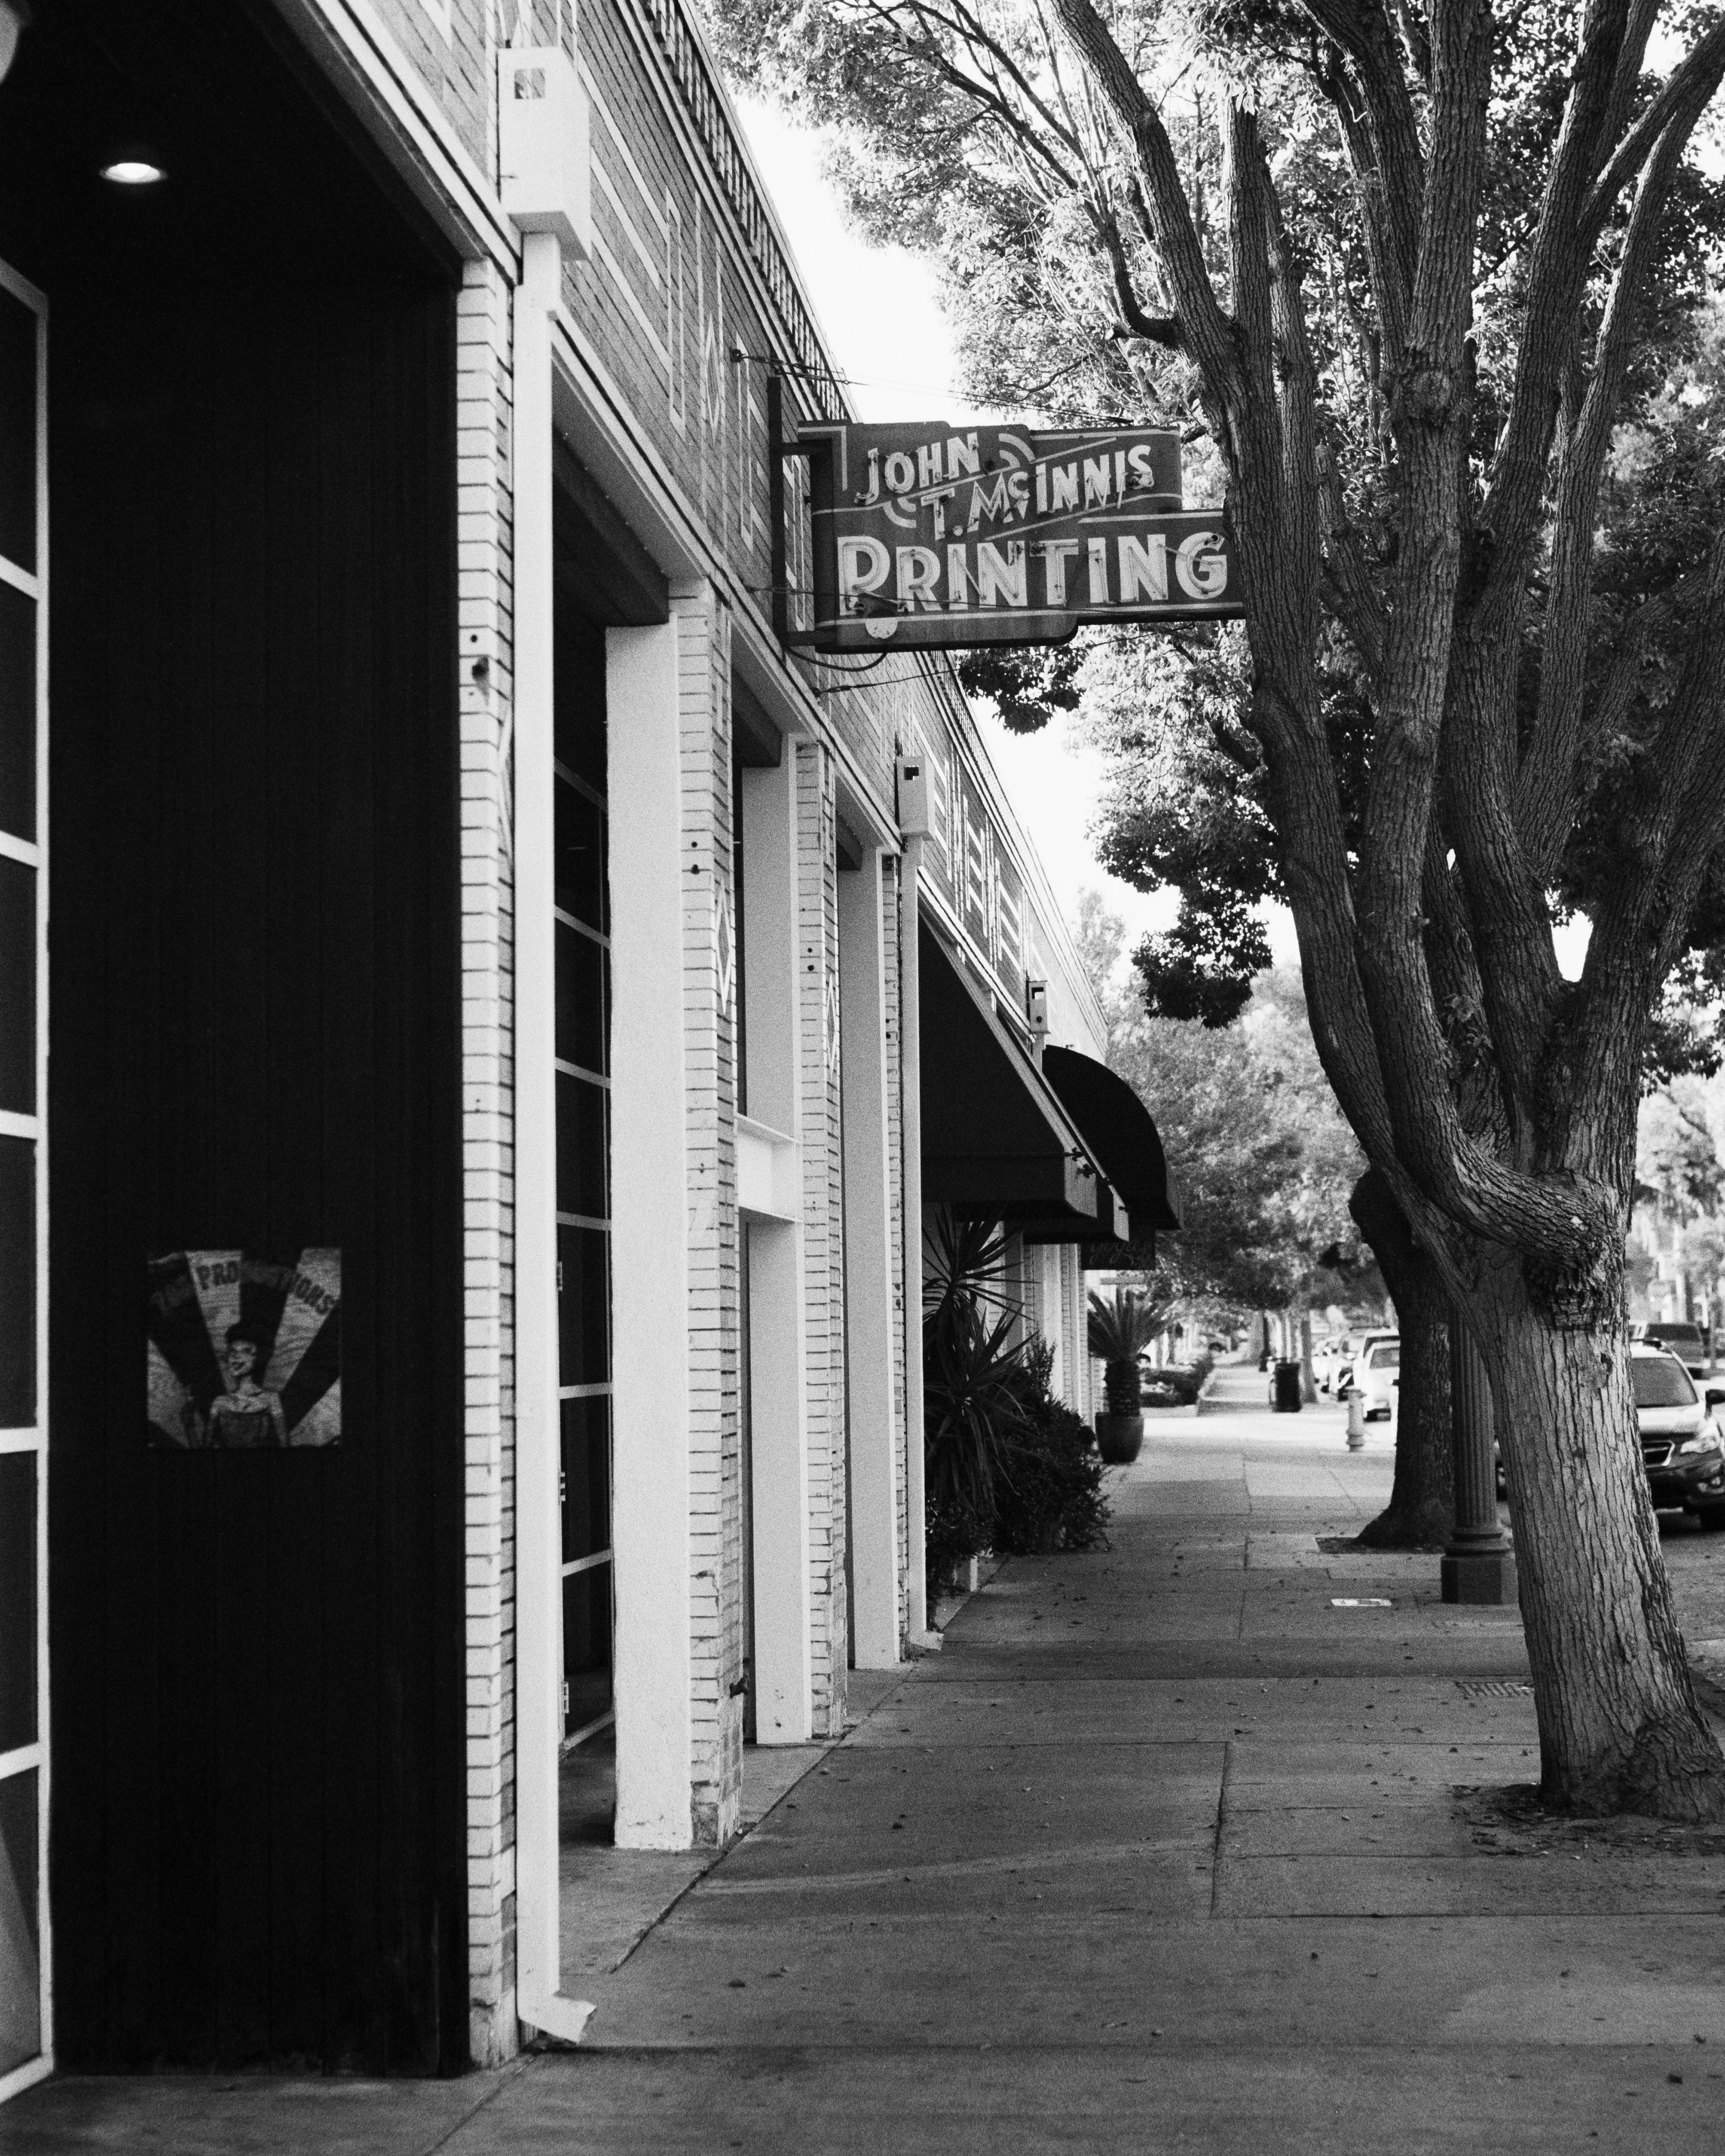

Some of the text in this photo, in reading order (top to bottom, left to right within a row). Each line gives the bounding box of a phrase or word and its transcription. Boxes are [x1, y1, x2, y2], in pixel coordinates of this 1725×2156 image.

[855, 433, 980, 504] JOHN
[920, 487, 964, 540] T.
[837, 532, 1228, 616] PRINTING
[196, 1260, 334, 1315] PROTIONS
